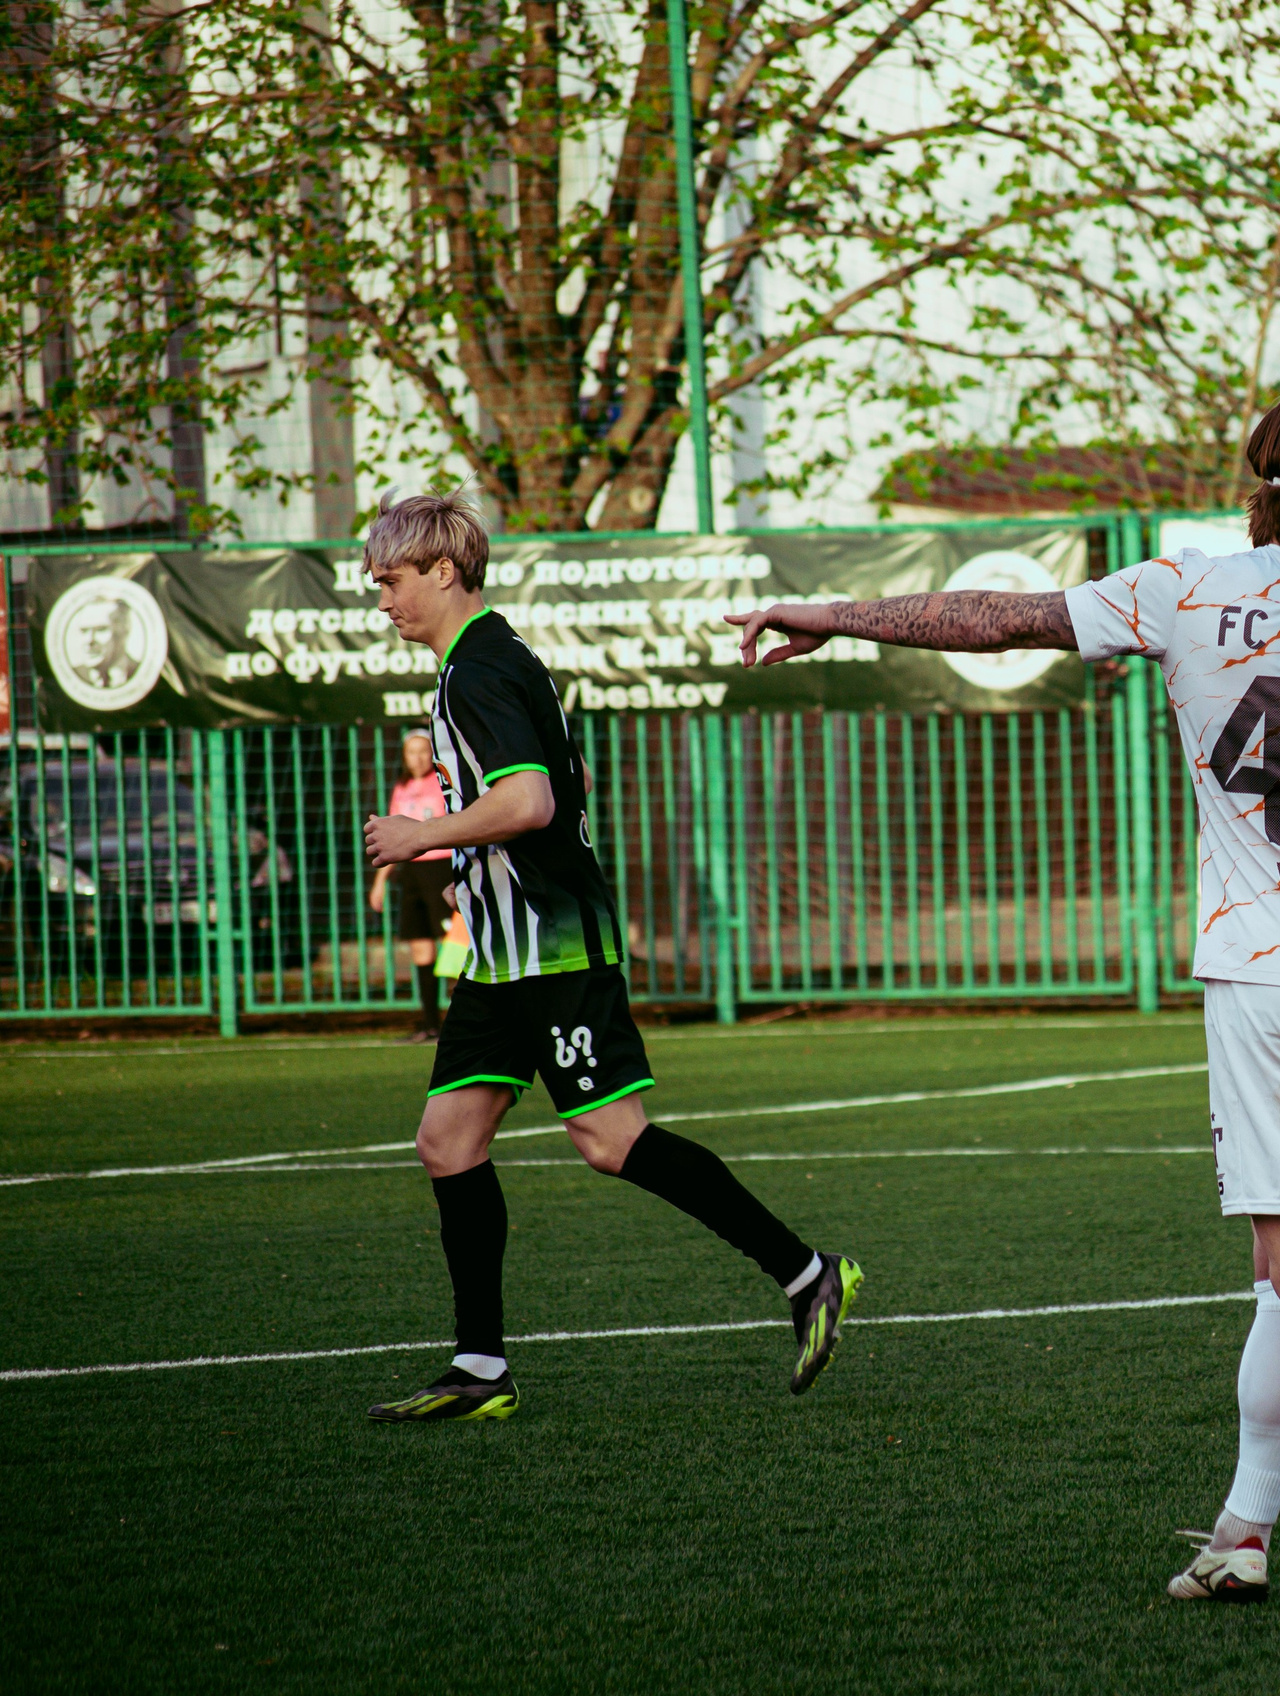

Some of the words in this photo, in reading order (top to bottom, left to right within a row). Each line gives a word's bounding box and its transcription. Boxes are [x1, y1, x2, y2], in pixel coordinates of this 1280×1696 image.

[534, 553, 772, 590] подготовке
[1217, 605, 1270, 649] FC
[226, 651, 278, 678] по
[284, 641, 438, 684] футбол
